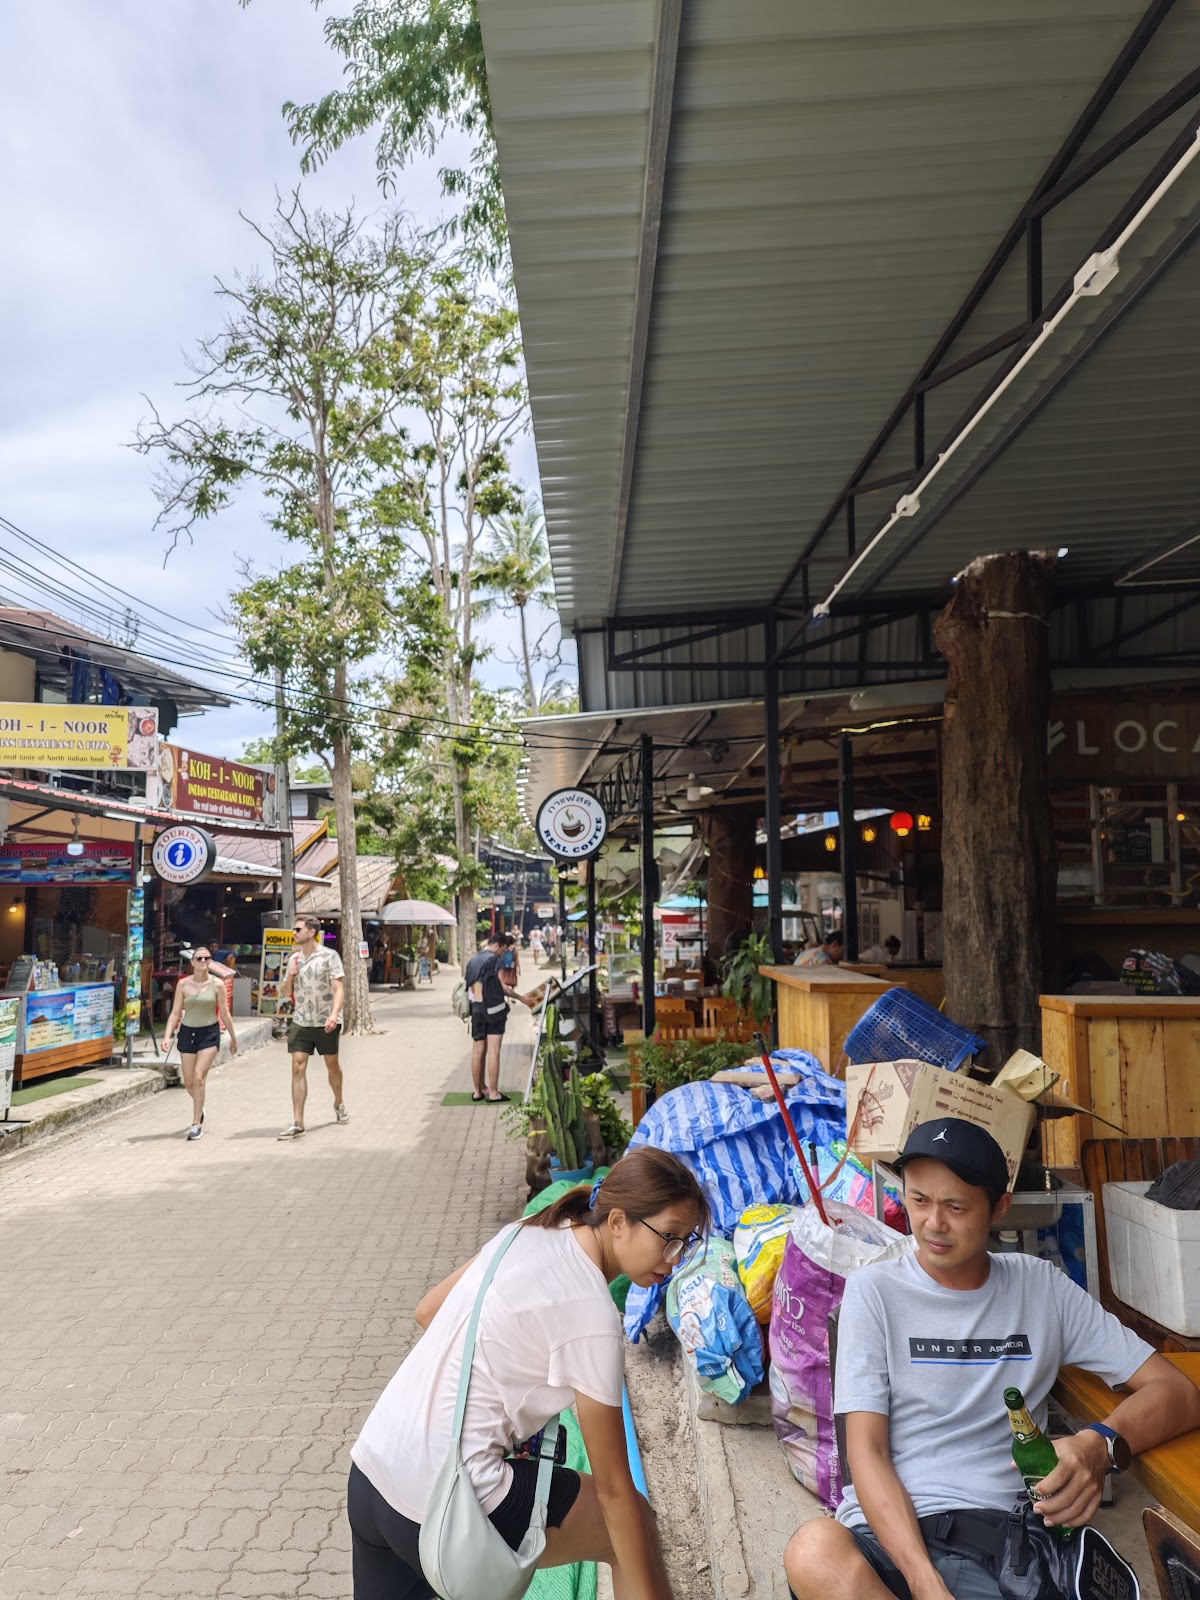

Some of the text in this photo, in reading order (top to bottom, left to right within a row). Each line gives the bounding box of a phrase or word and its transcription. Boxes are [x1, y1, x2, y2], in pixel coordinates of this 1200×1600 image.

[64, 721, 108, 734] NOOR
[18, 738, 75, 749] RESTAURANT
[86, 741, 111, 750] PIZZA
[190, 759, 211, 780] KOH
[232, 770, 255, 791] NOOR
[188, 783, 207, 797] INDIAN
[207, 787, 238, 804] RESTAURANT
[548, 794, 592, 814] กาแฟสด
[158, 829, 201, 849] TOURIST
[544, 817, 602, 853] REAL COFFEE
[157, 858, 203, 880] INFORMATION
[917, 1341, 1024, 1353] UNDER ARMOUR
